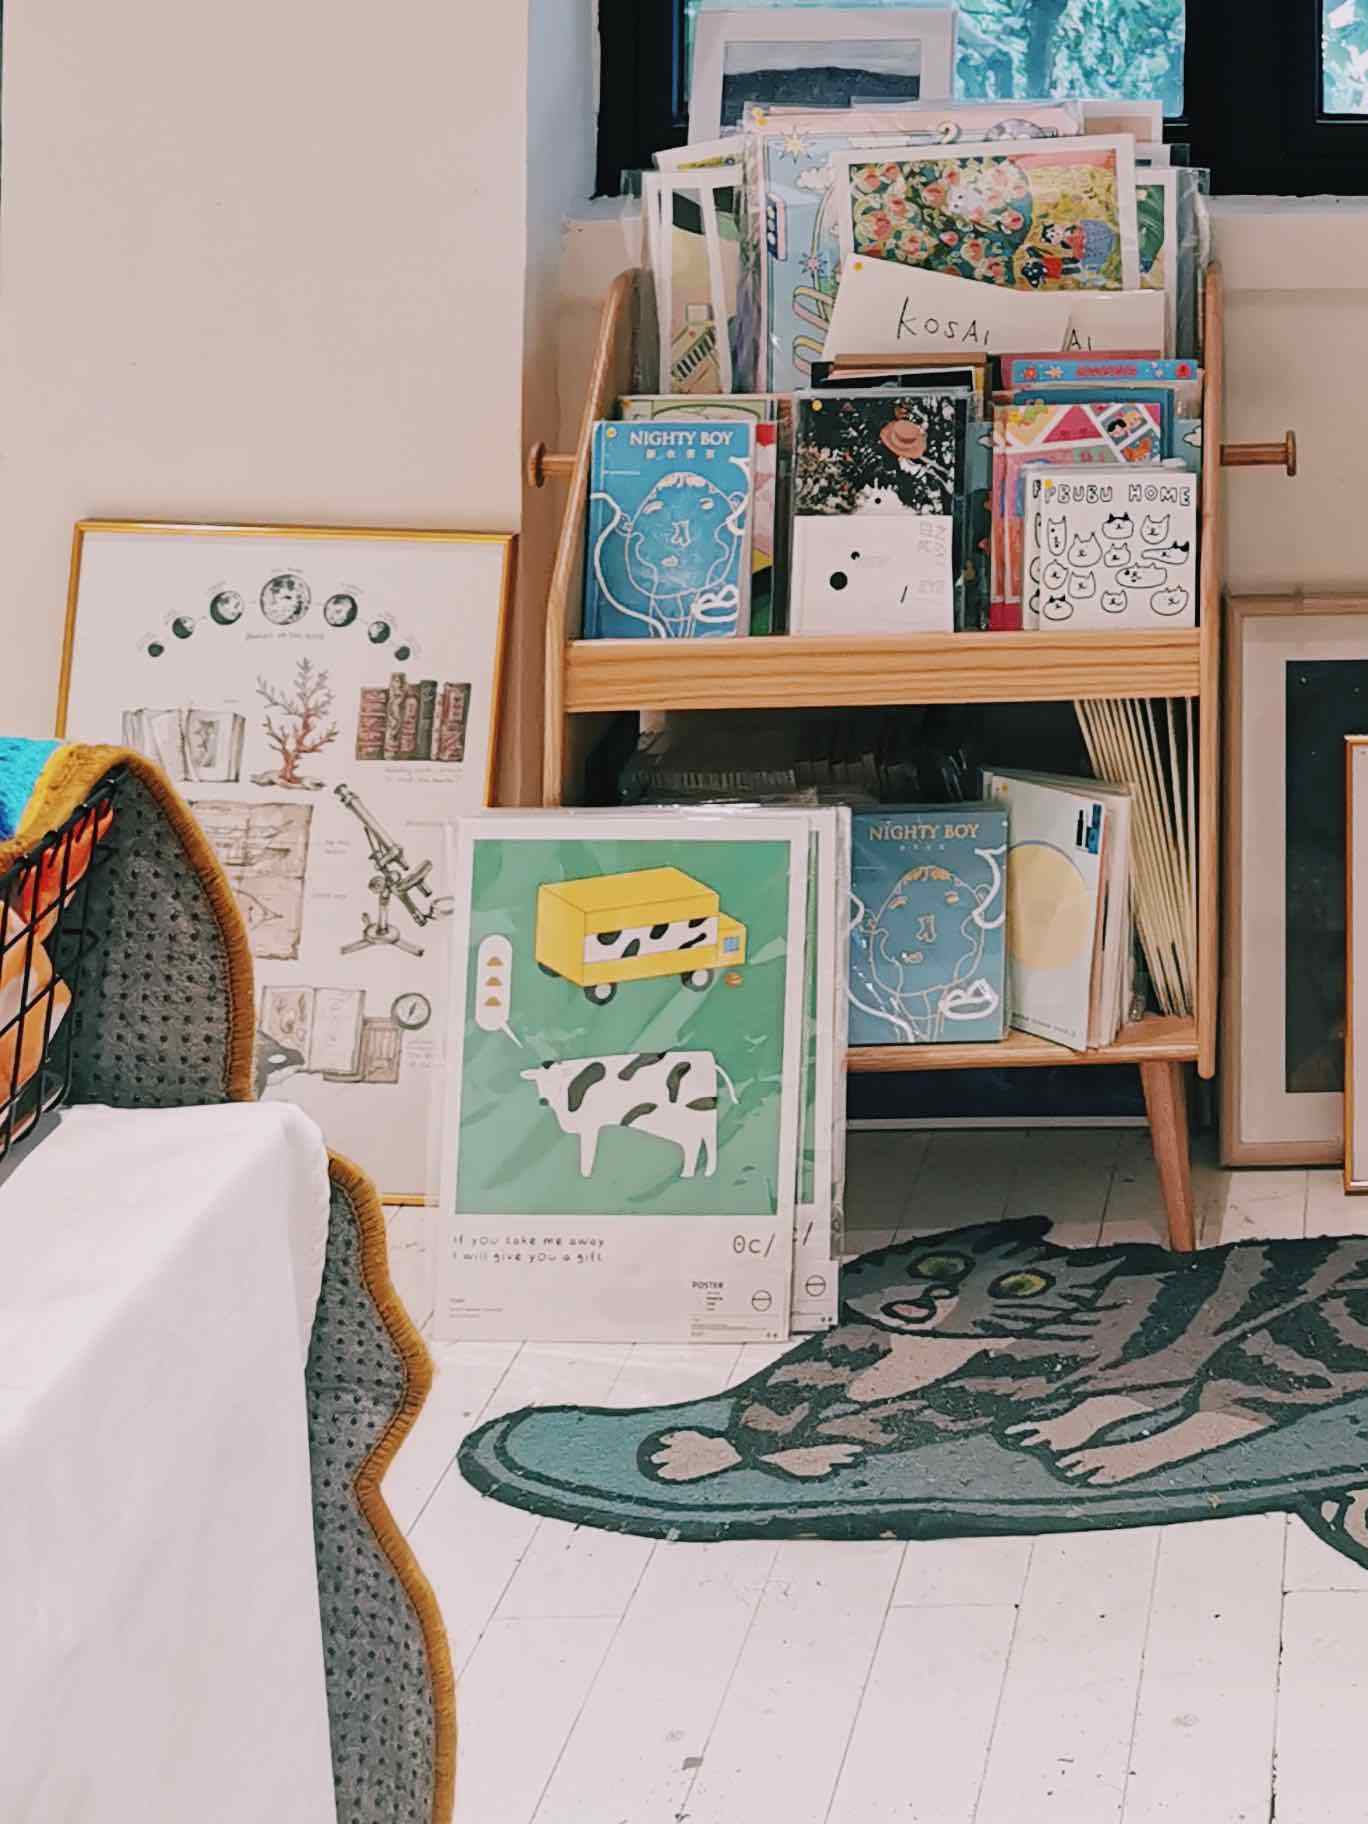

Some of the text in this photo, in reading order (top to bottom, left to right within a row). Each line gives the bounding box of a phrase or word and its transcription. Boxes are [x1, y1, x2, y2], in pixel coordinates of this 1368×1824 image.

[630, 431, 733, 446] NIGHTY BOY
[1128, 483, 1191, 506] HOME
[869, 823, 979, 841] NIGHTY BOY
[543, 1236, 562, 1247] me
[568, 1237, 606, 1248] away
[492, 1252, 522, 1264] give
[529, 1252, 557, 1264] you
[691, 1280, 725, 1289] POSTER
